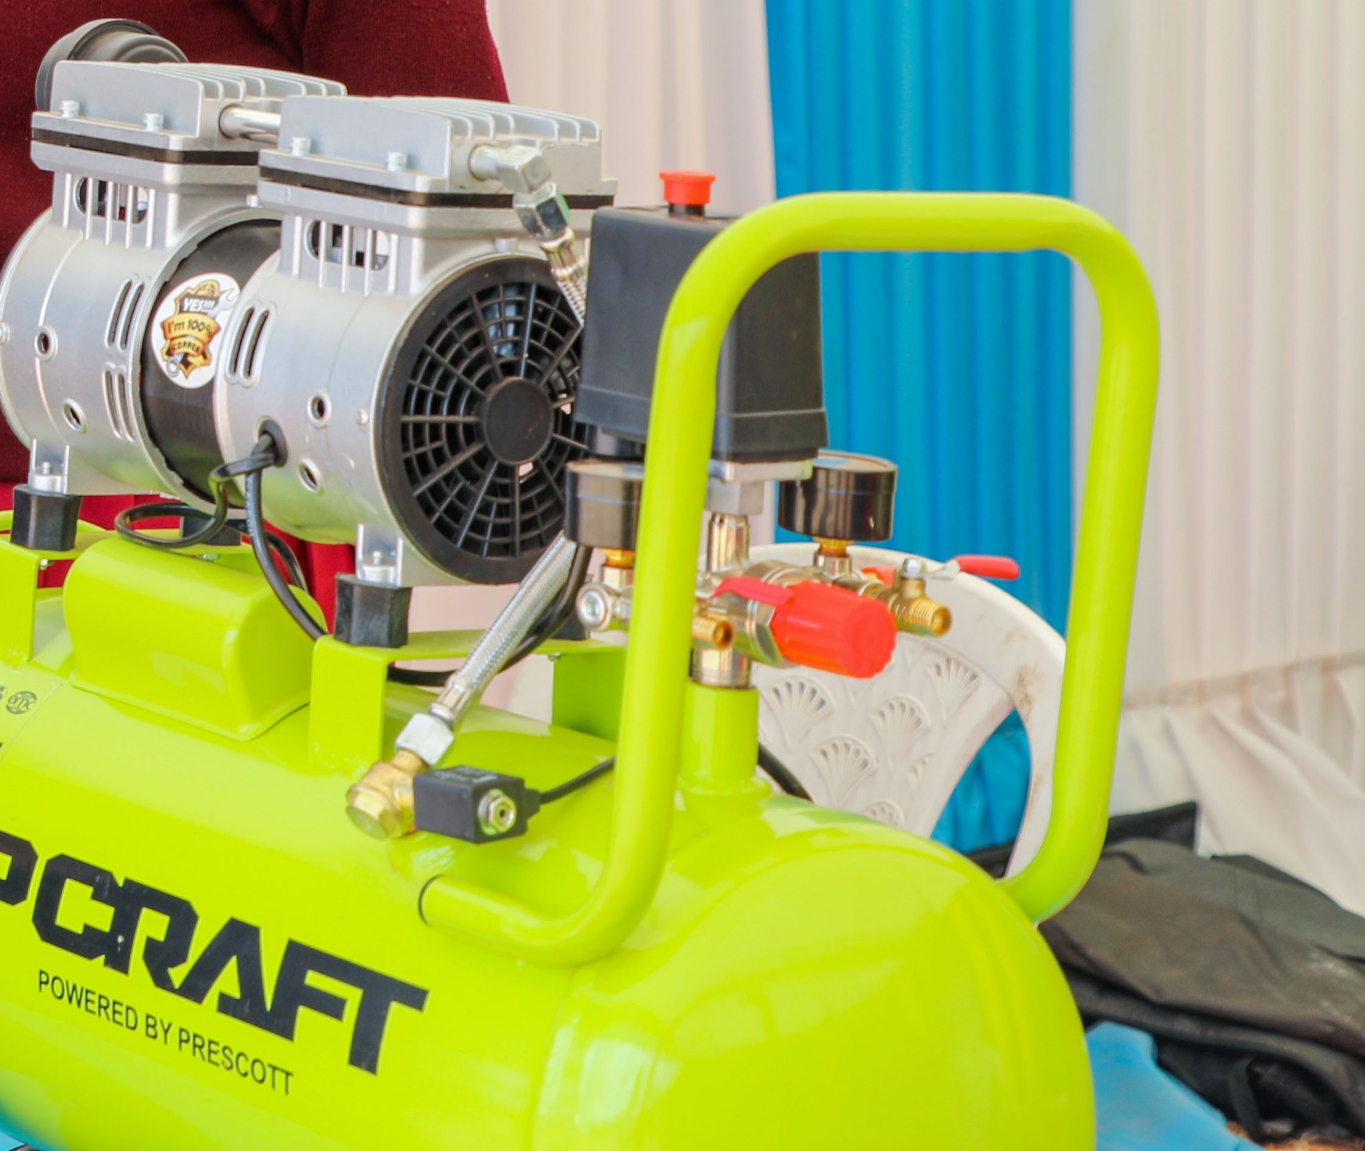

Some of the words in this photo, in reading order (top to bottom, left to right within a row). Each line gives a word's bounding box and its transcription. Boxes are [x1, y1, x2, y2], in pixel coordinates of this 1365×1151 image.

[168, 320, 185, 335] I'm
[38, 969, 139, 1032] POWERED
[145, 1013, 173, 1046] BY
[177, 1027, 294, 1095] PRESCOTT
